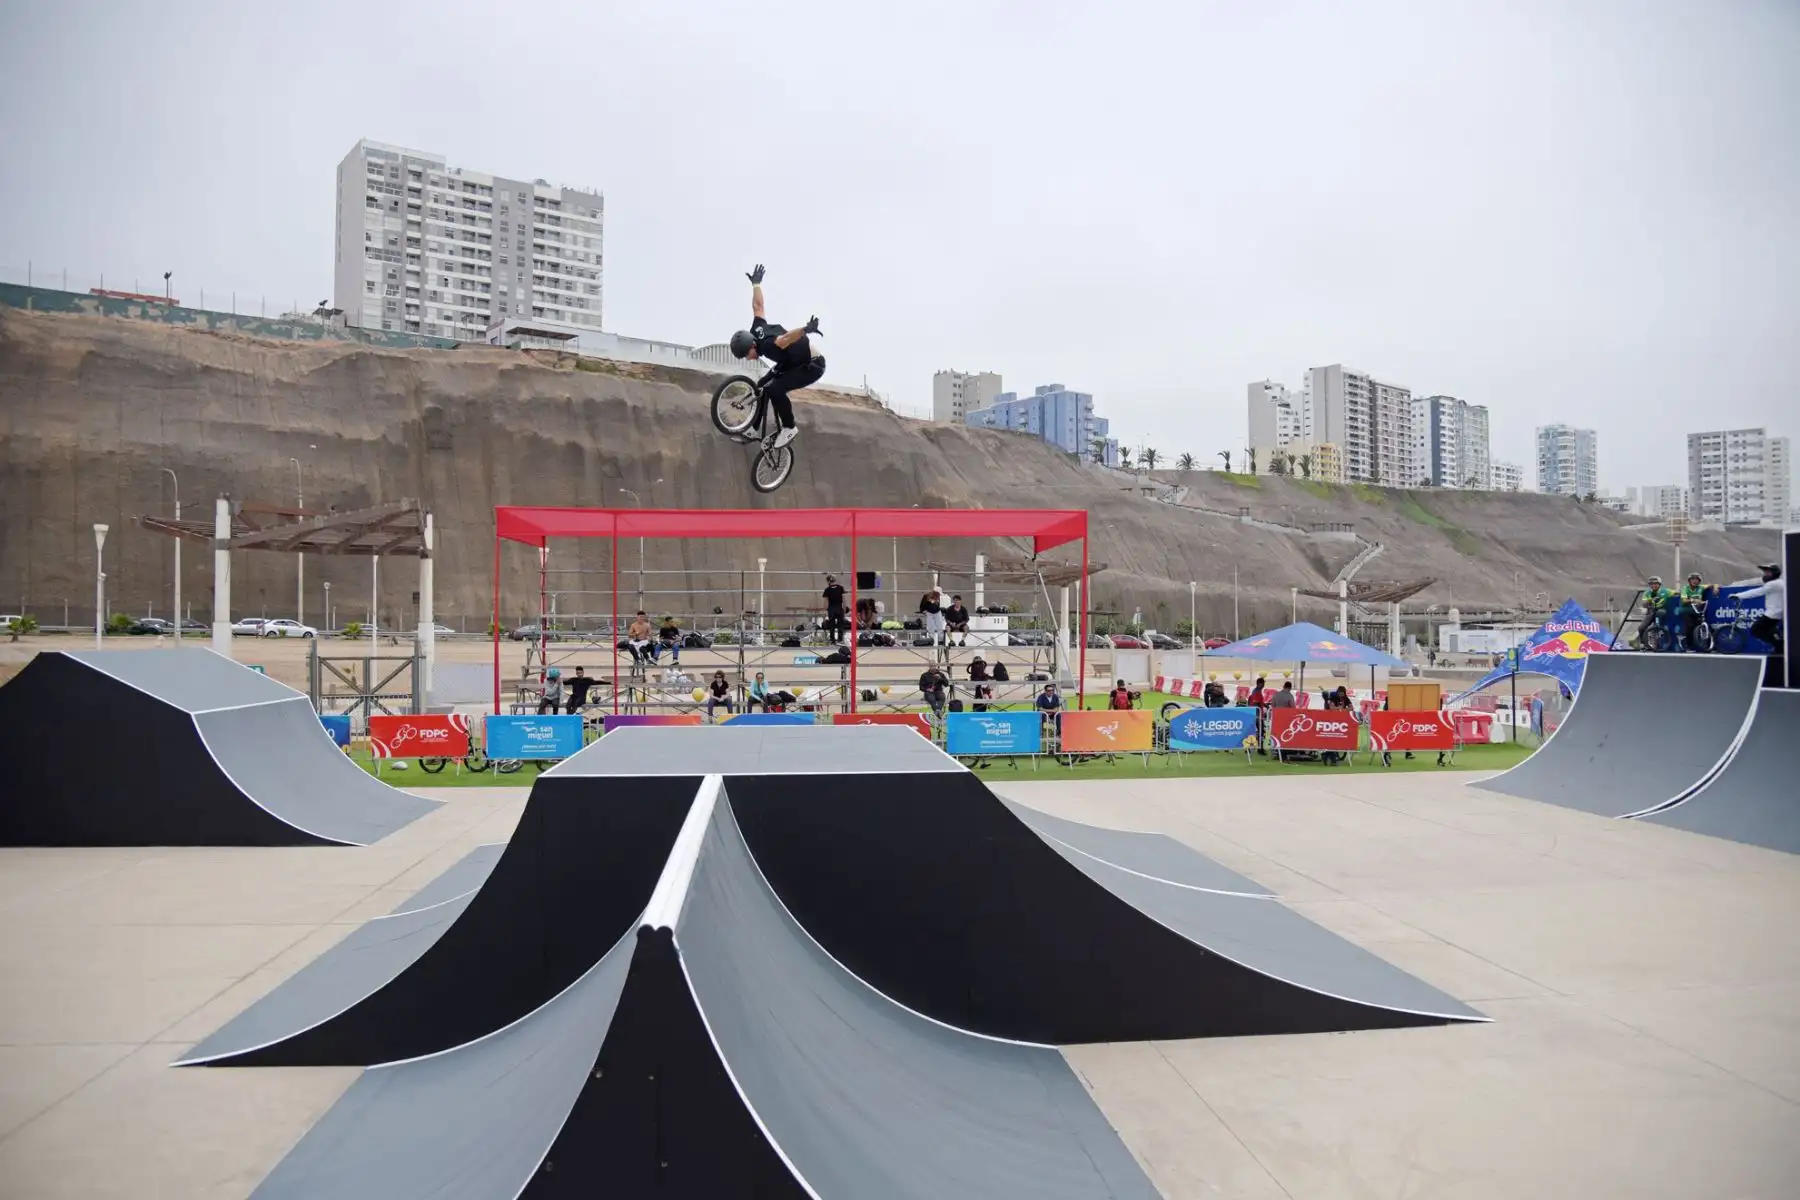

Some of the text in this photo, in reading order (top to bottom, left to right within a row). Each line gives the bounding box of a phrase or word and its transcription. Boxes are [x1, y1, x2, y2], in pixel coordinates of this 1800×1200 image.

[1546, 620, 1600, 632] Red Bull
[1316, 721, 1349, 732] FDPC
[1412, 724, 1438, 732] FDPC
[420, 728, 449, 738] FDPC
